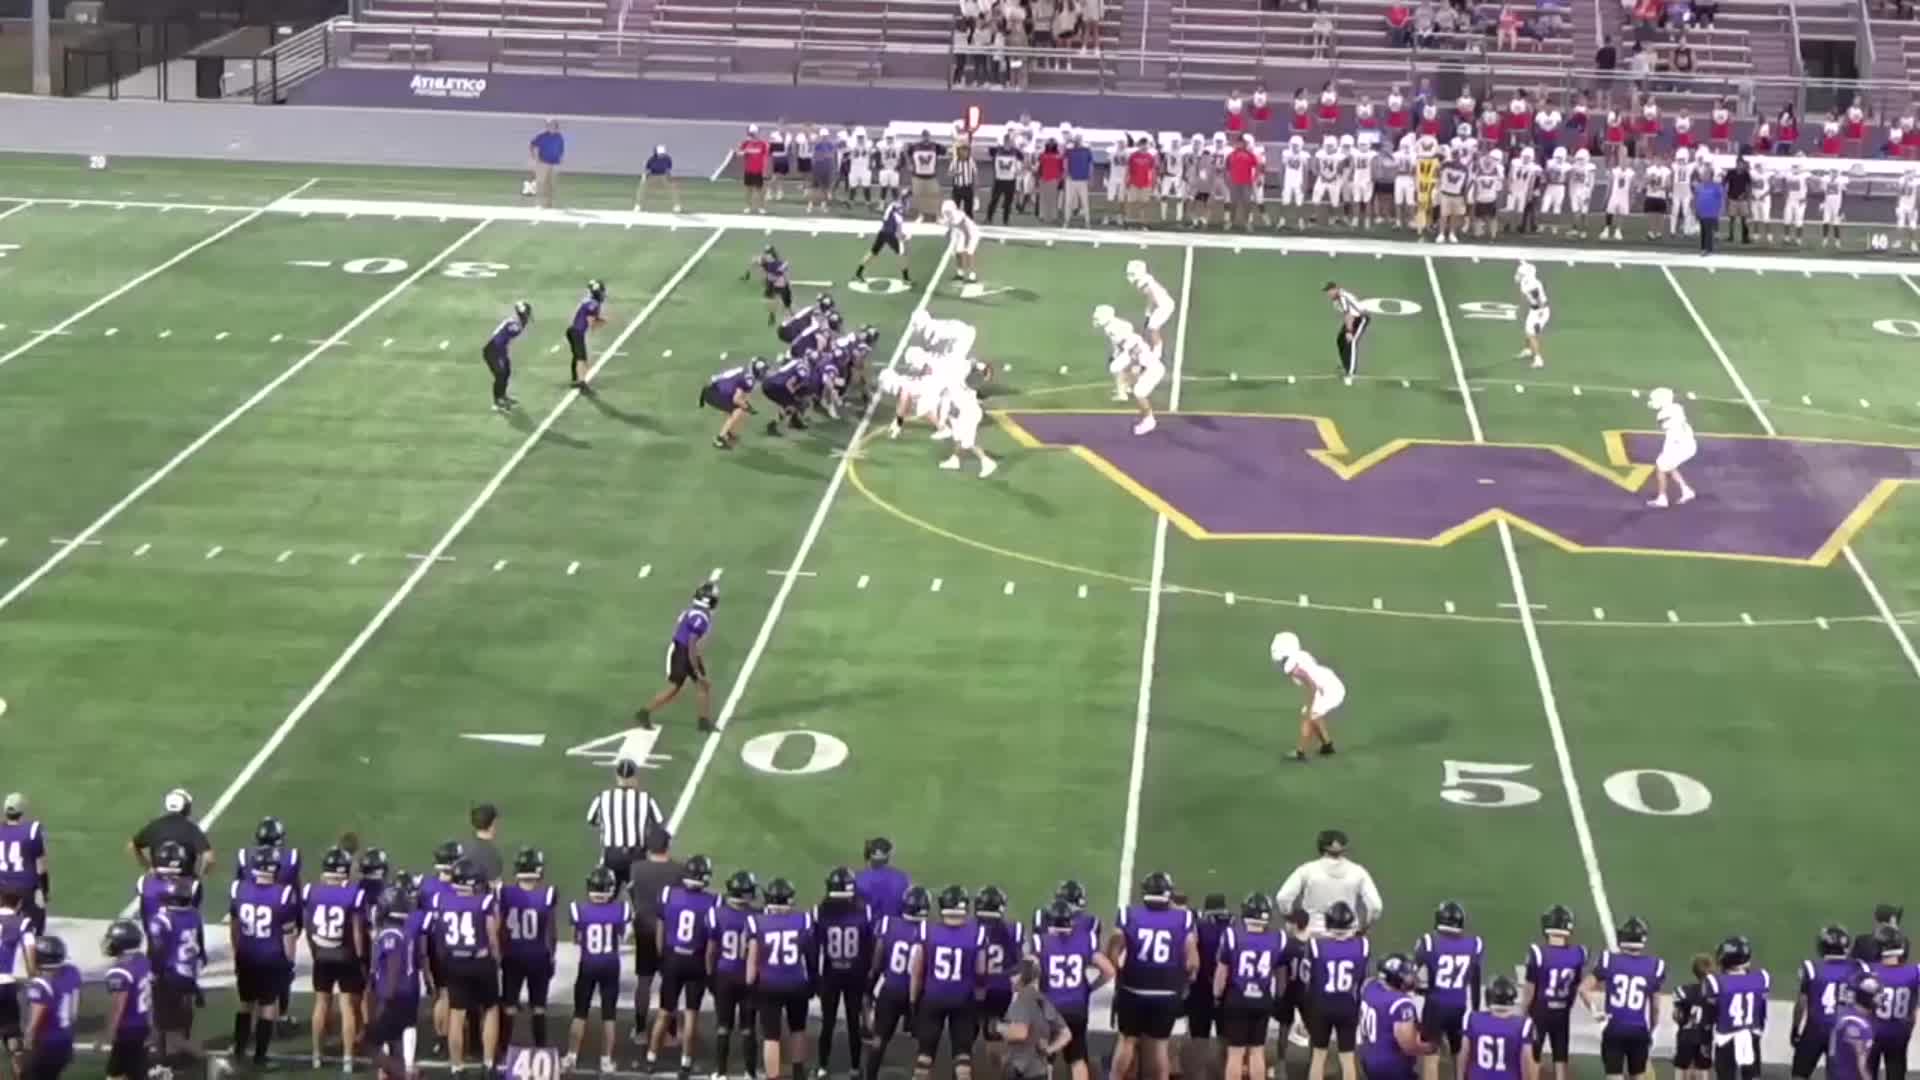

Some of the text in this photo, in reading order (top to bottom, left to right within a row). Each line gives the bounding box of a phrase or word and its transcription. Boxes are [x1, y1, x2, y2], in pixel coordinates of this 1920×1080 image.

[240, 903, 272, 938] 92
[313, 904, 344, 938] 42
[443, 911, 476, 946] 34
[506, 907, 539, 940] 40
[676, 909, 695, 943] 8
[586, 923, 613, 955] 81
[765, 930, 799, 965] 75
[1137, 928, 1172, 963] 76
[934, 946, 963, 981] 51
[1049, 954, 1083, 988] 53
[1325, 960, 1354, 993] 16
[1436, 955, 1470, 988] 27
[1610, 973, 1647, 1010] 36
[1876, 987, 1911, 1018] 38
[1729, 992, 1755, 1026] 41
[512, 1049, 551, 1080] 40
[1477, 1035, 1506, 1071] 61
